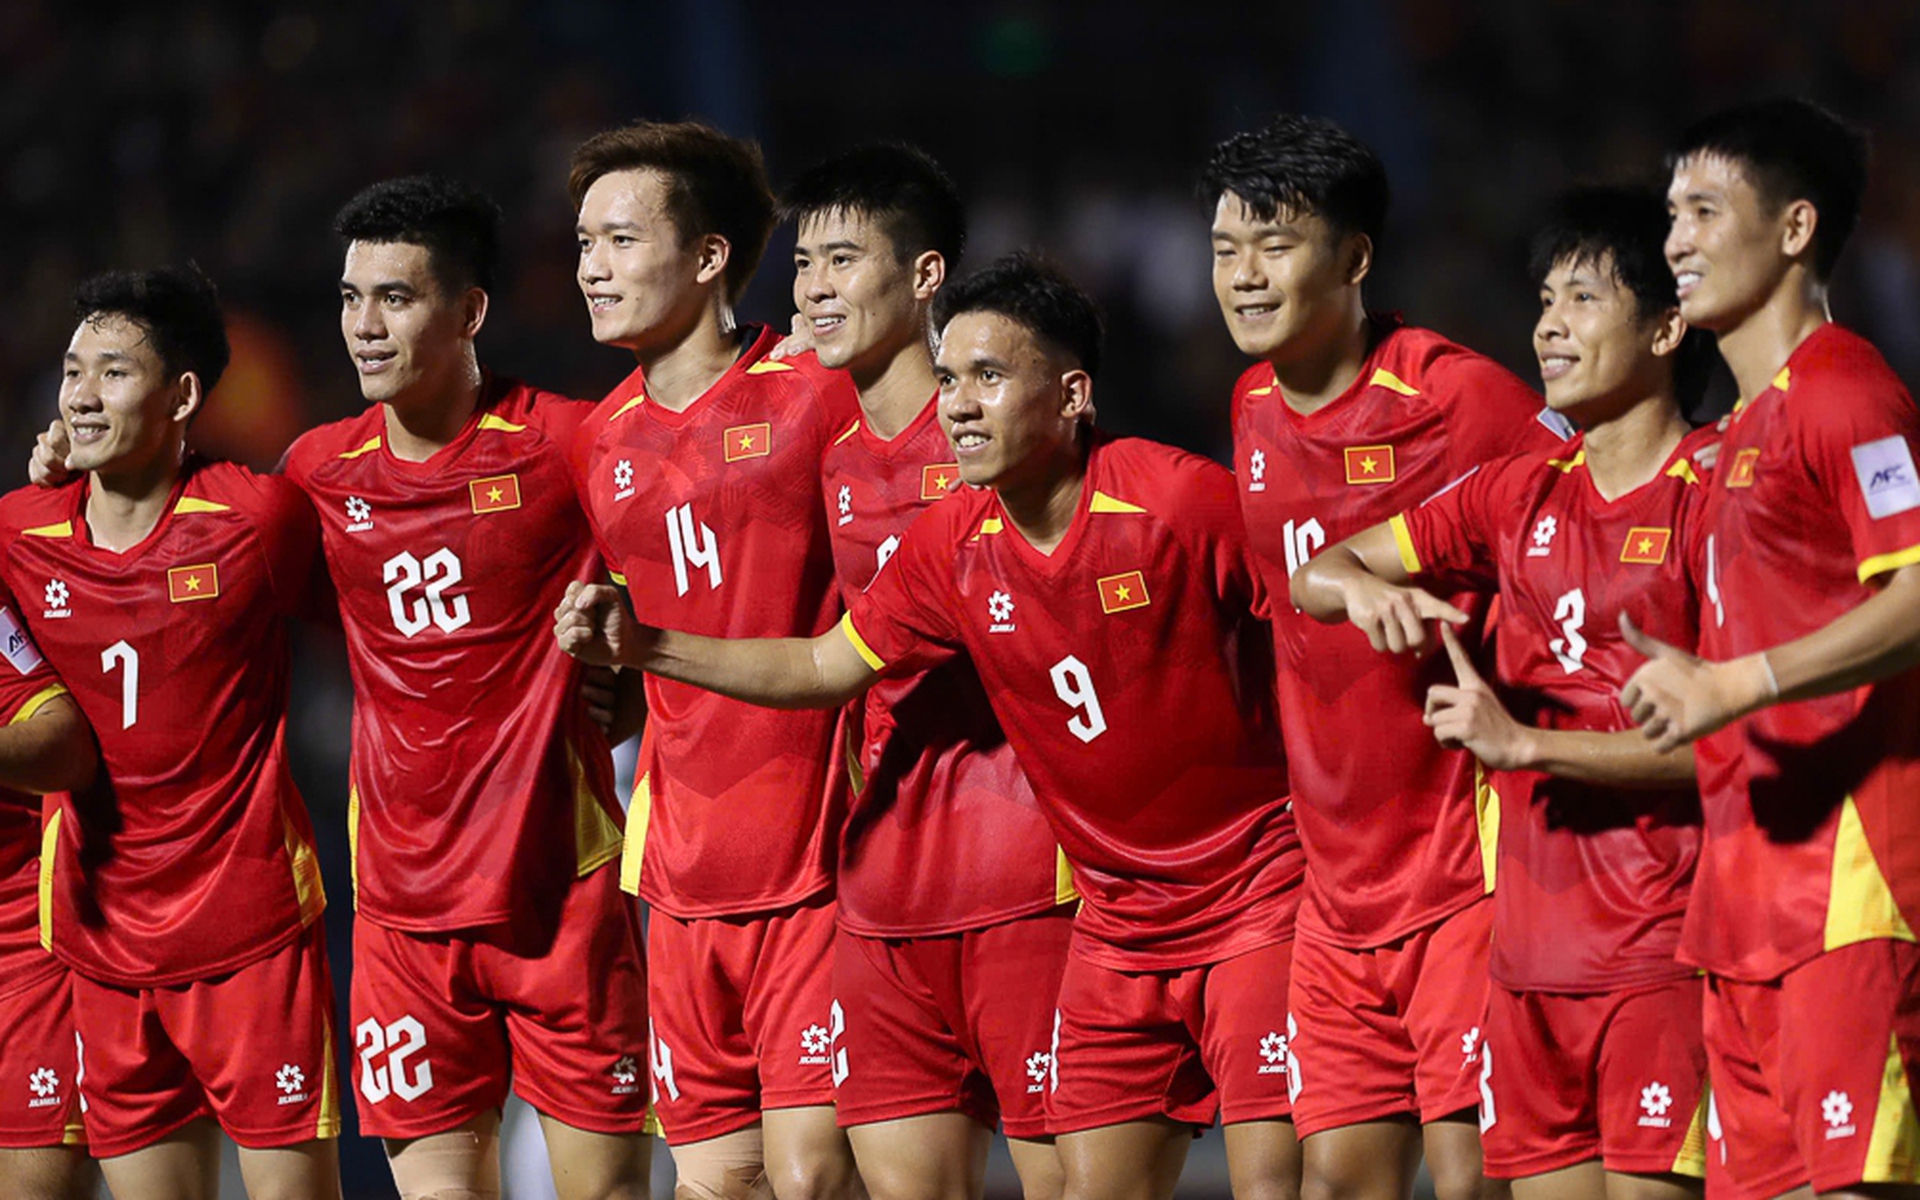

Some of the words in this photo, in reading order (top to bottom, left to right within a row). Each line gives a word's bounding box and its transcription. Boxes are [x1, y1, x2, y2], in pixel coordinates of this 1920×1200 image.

[383, 547, 471, 638] 22
[666, 502, 723, 597] 14
[1550, 588, 1587, 675] 3
[101, 640, 139, 730] 7
[1049, 654, 1107, 743] 9
[356, 1014, 433, 1105] 22
